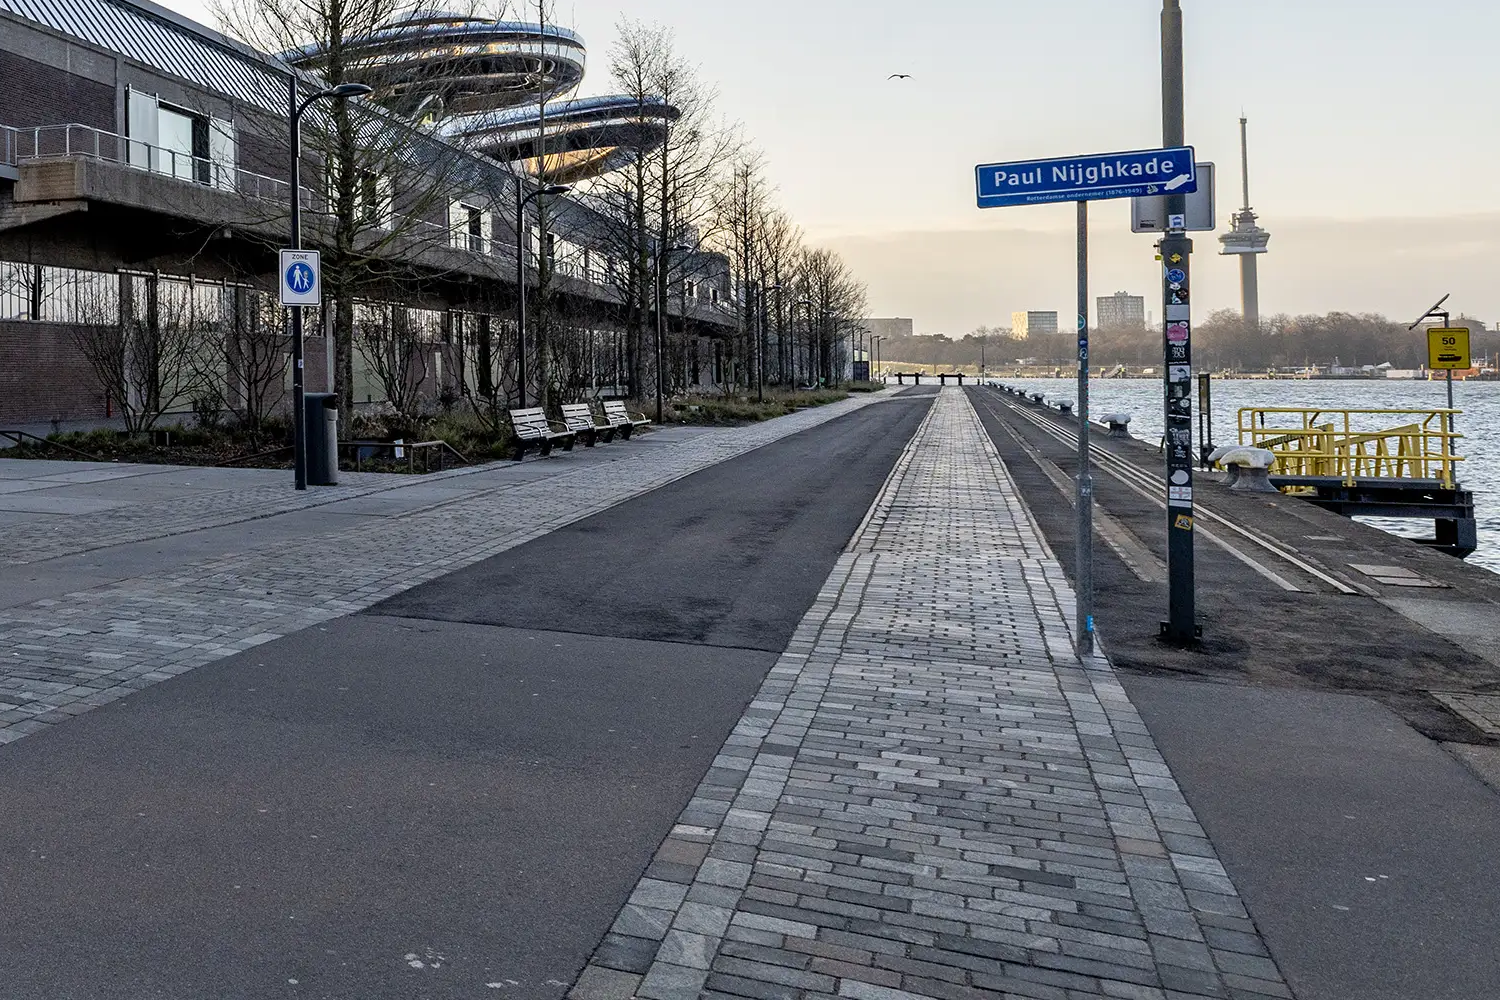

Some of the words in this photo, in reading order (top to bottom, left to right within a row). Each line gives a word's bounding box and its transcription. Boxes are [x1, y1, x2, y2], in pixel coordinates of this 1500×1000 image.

[994, 167, 1042, 187] Paul
[1052, 157, 1175, 185] Nijghkade
[1026, 193, 1065, 202] Rotterdamse
[1066, 190, 1104, 199] ondernemer
[1105, 187, 1143, 198] (1876-1949)
[1442, 336, 1456, 345] 50
